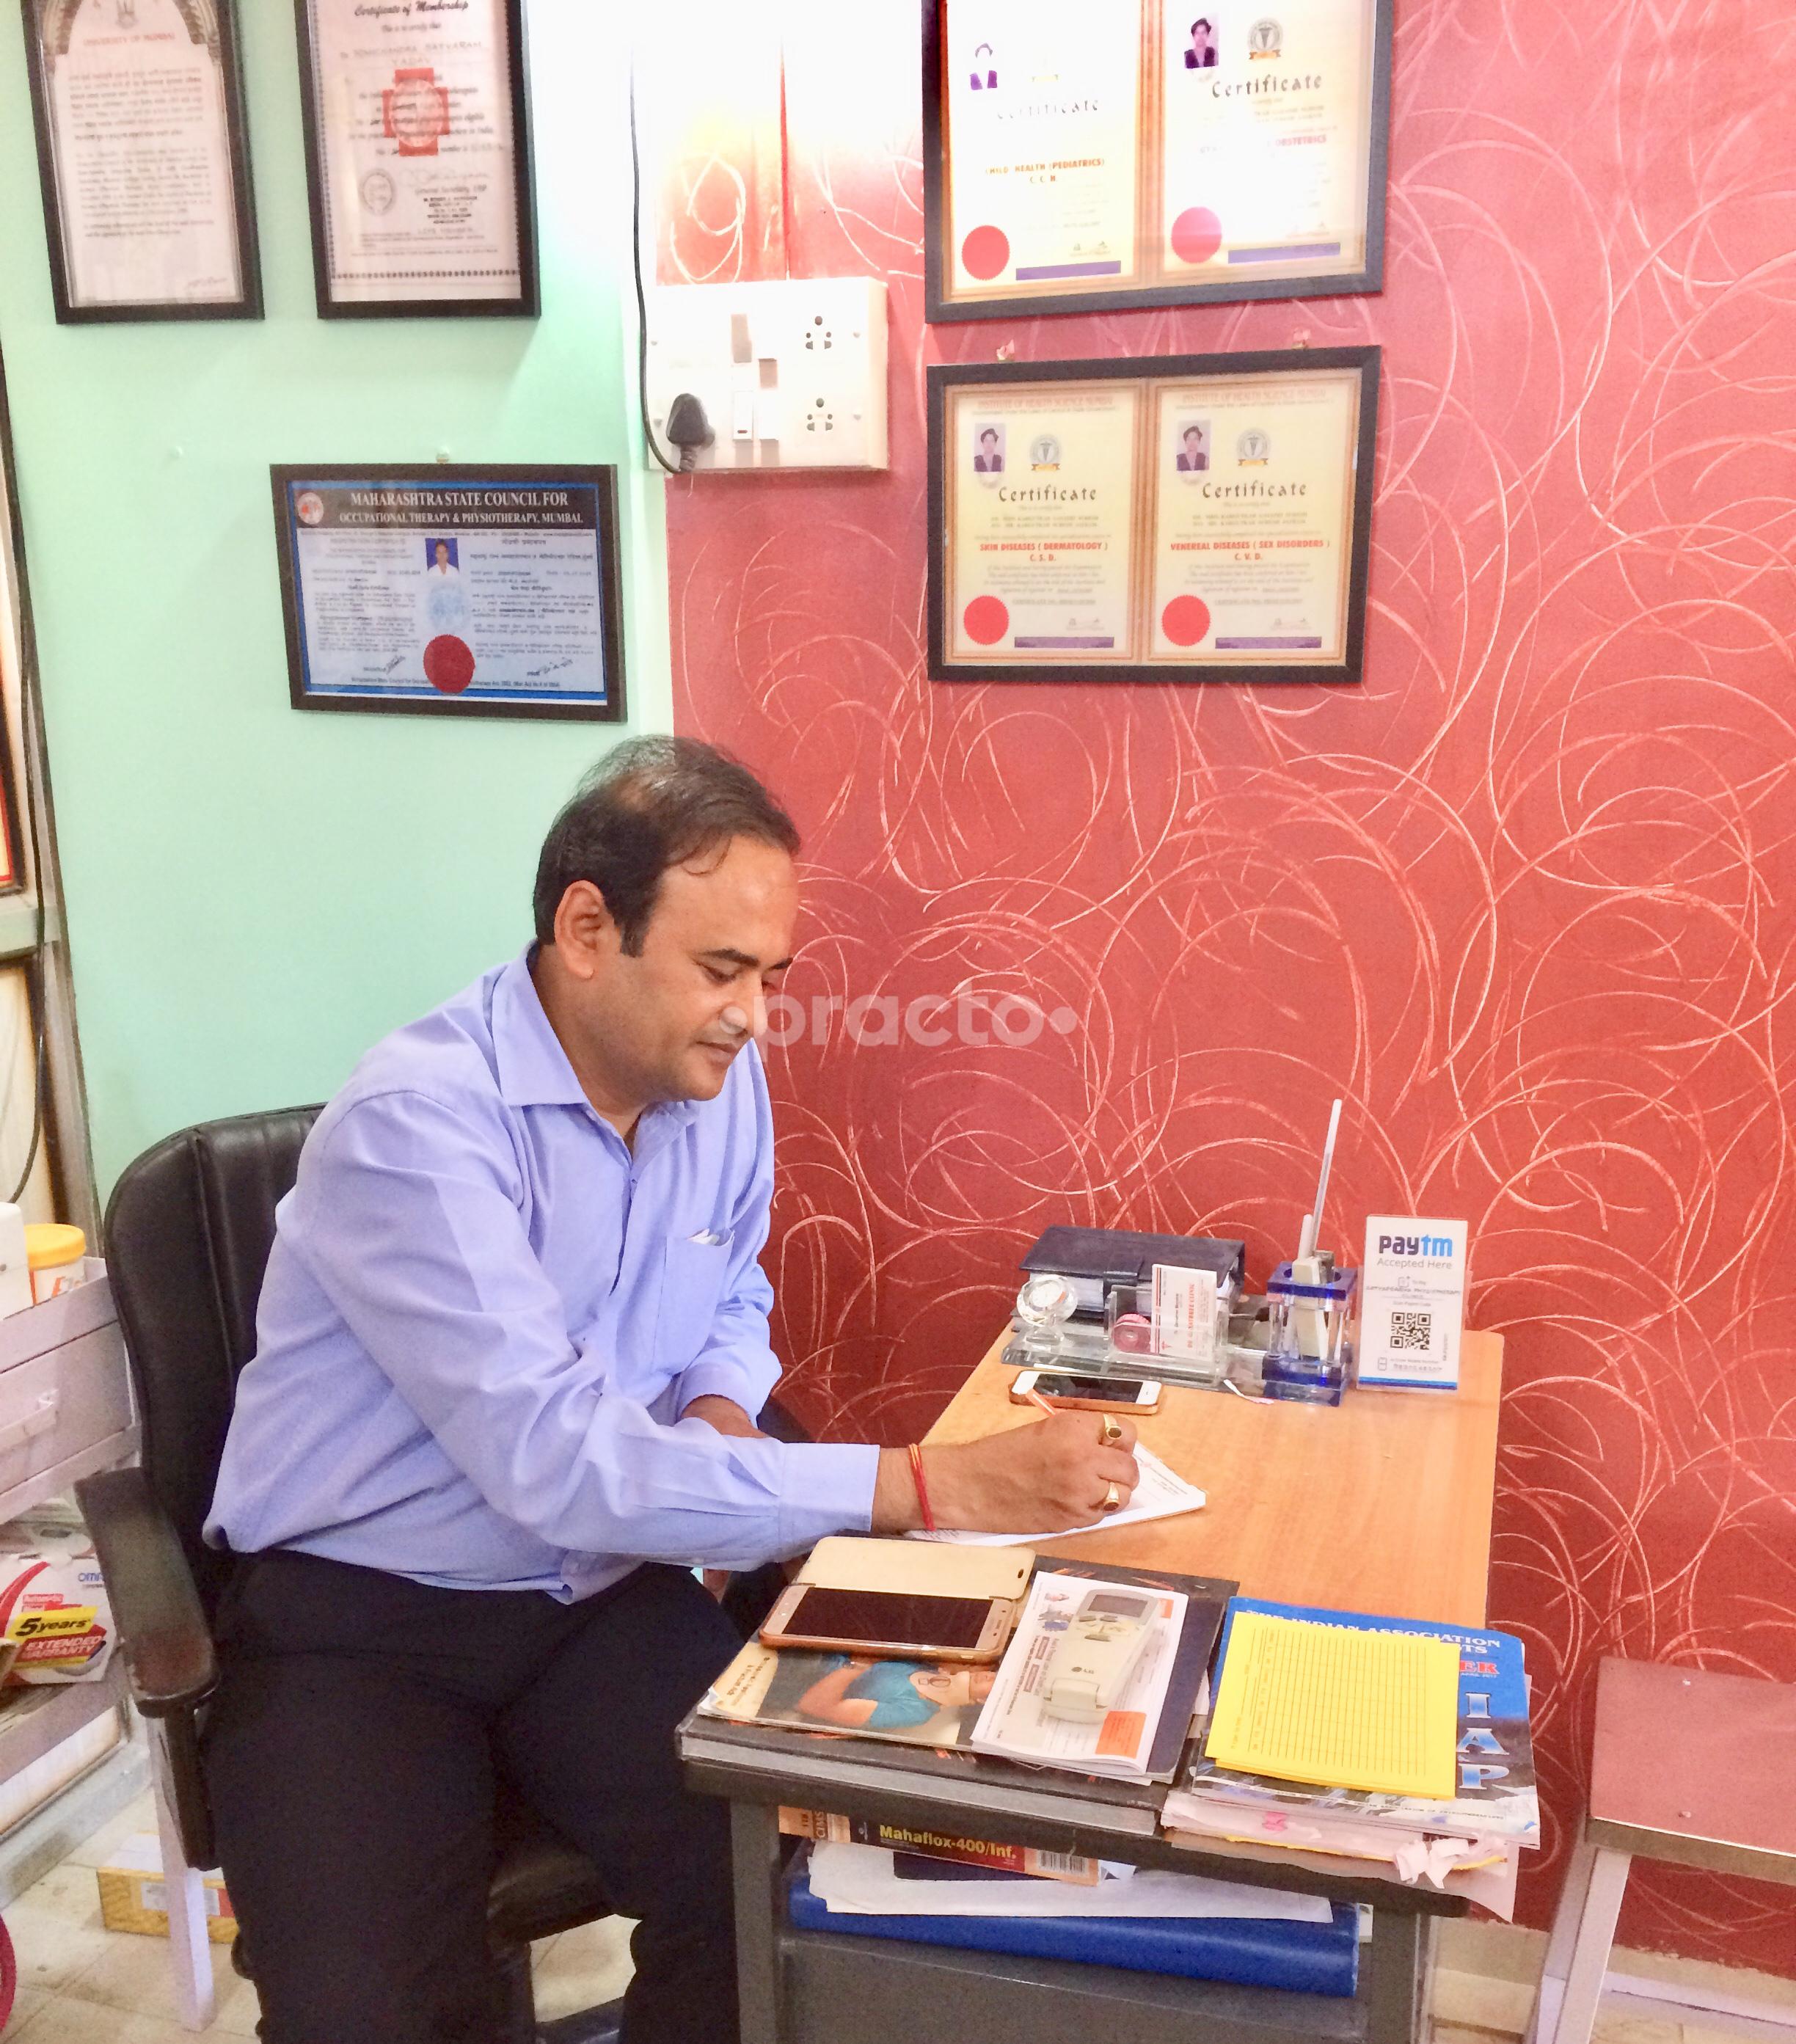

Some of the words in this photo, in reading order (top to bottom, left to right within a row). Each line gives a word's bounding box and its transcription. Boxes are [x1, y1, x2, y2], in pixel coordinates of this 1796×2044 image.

[354, 4, 401, 18] Certificate
[1212, 73, 1322, 98] Certificate
[999, 484, 1098, 502] Certificate
[1202, 480, 1307, 498] Certificate
[350, 492, 443, 506] MAHARASHTRA
[445, 492, 482, 506] STATE
[484, 492, 541, 506] COUNCIL
[543, 492, 569, 506] FOR
[339, 512, 405, 523] OCCUPATIONAL
[409, 513, 450, 523] THERAPY
[452, 514, 461, 523] &
[980, 543, 999, 551] SKIN
[1001, 542, 1036, 551] DISEASES
[1043, 541, 1103, 551] DERMATOLOGY
[1170, 542, 1211, 551] VENEREAL
[1213, 541, 1250, 550] DISEASES
[1259, 540, 1274, 549] SEX
[1277, 539, 1324, 548] DISORDERS
[1376, 1258, 1425, 1269] Accepted
[1427, 1260, 1453, 1270] Here
[25, 1635, 103, 1651] EXTENDED
[880, 1824, 1018, 1860] Mahaflox-400/Inf.
